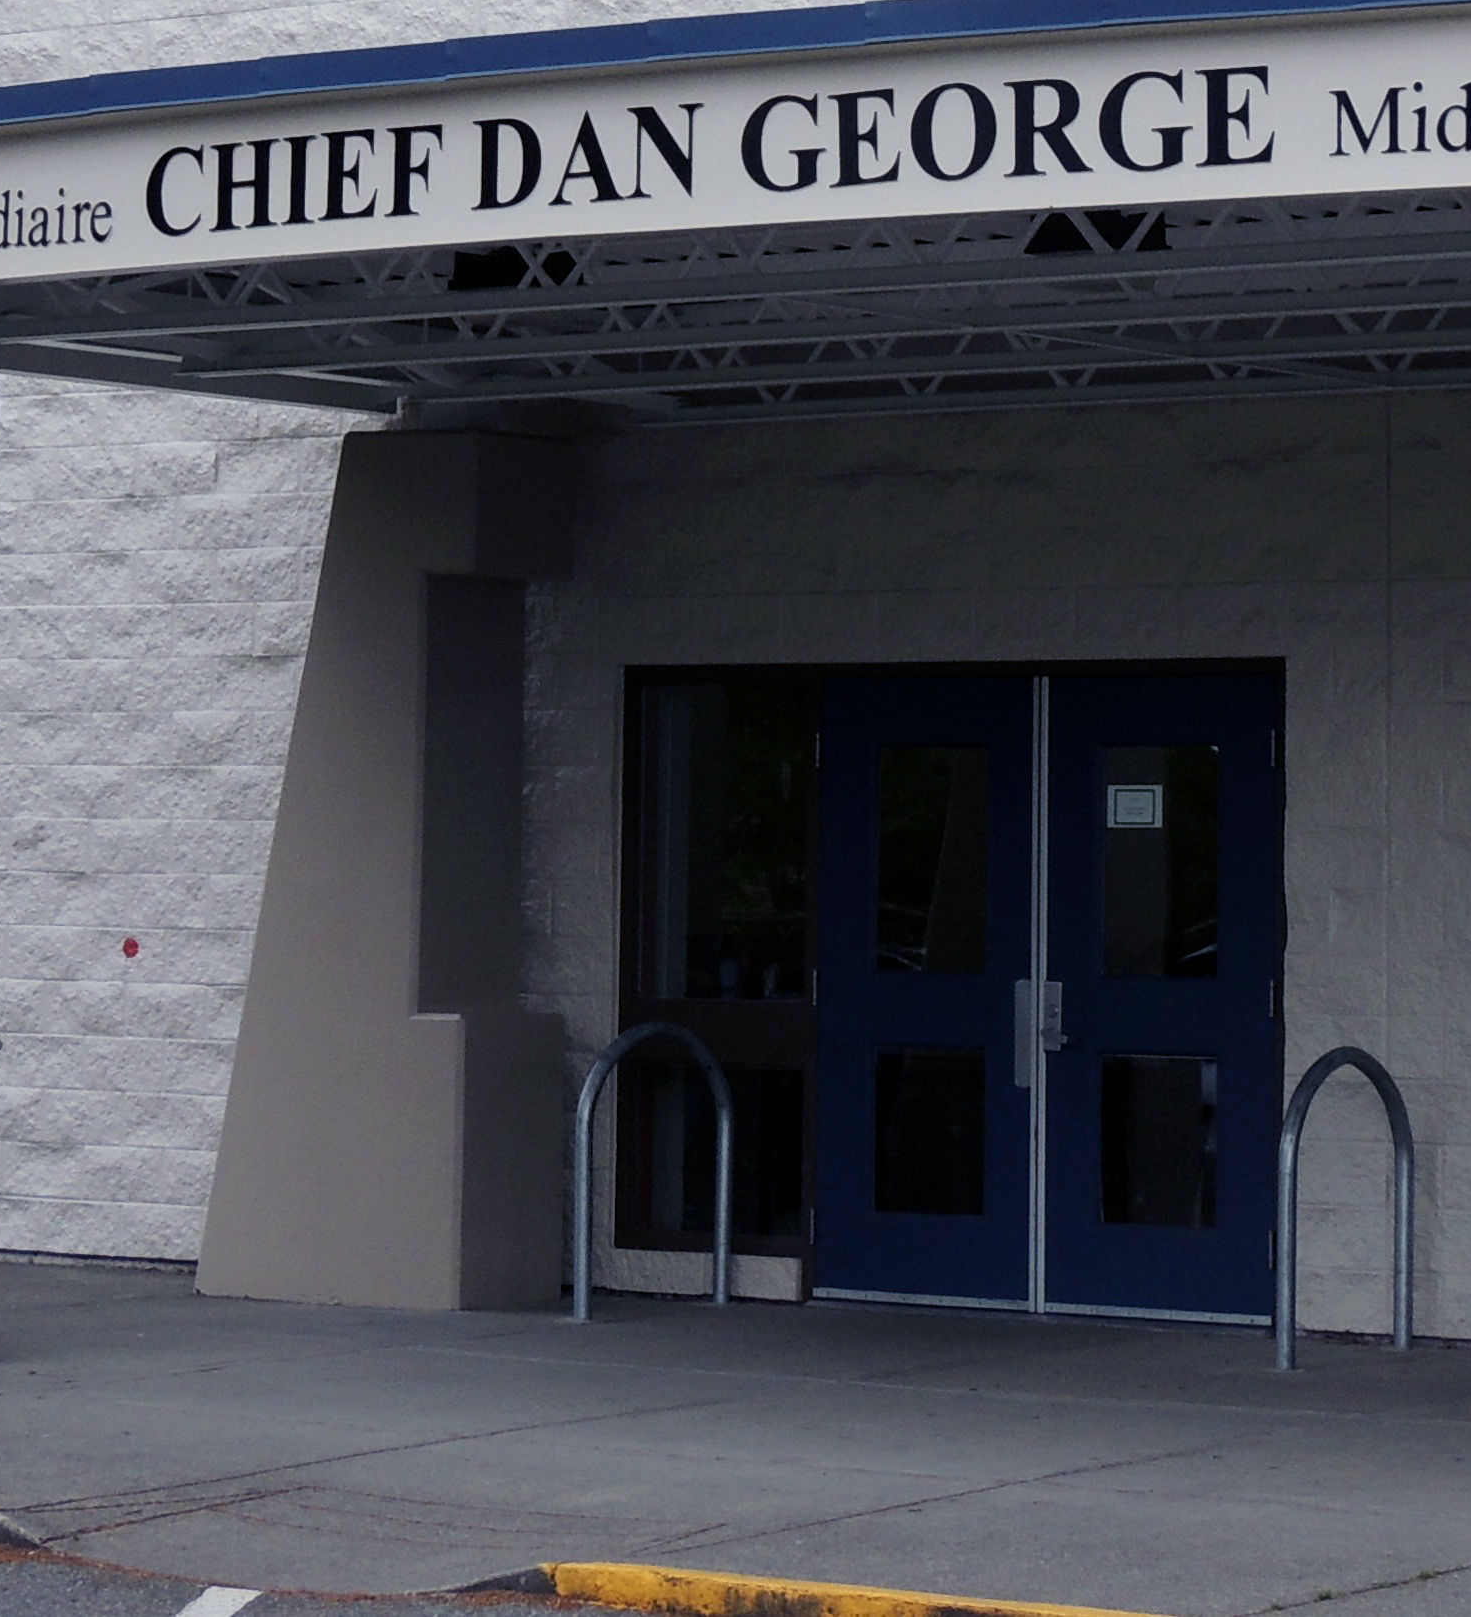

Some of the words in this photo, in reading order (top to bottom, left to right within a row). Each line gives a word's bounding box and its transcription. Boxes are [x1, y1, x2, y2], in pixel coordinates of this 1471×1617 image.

[144, 122, 445, 238] CHIEF
[469, 101, 706, 212] DAN
[739, 64, 1276, 194] GEORGE
